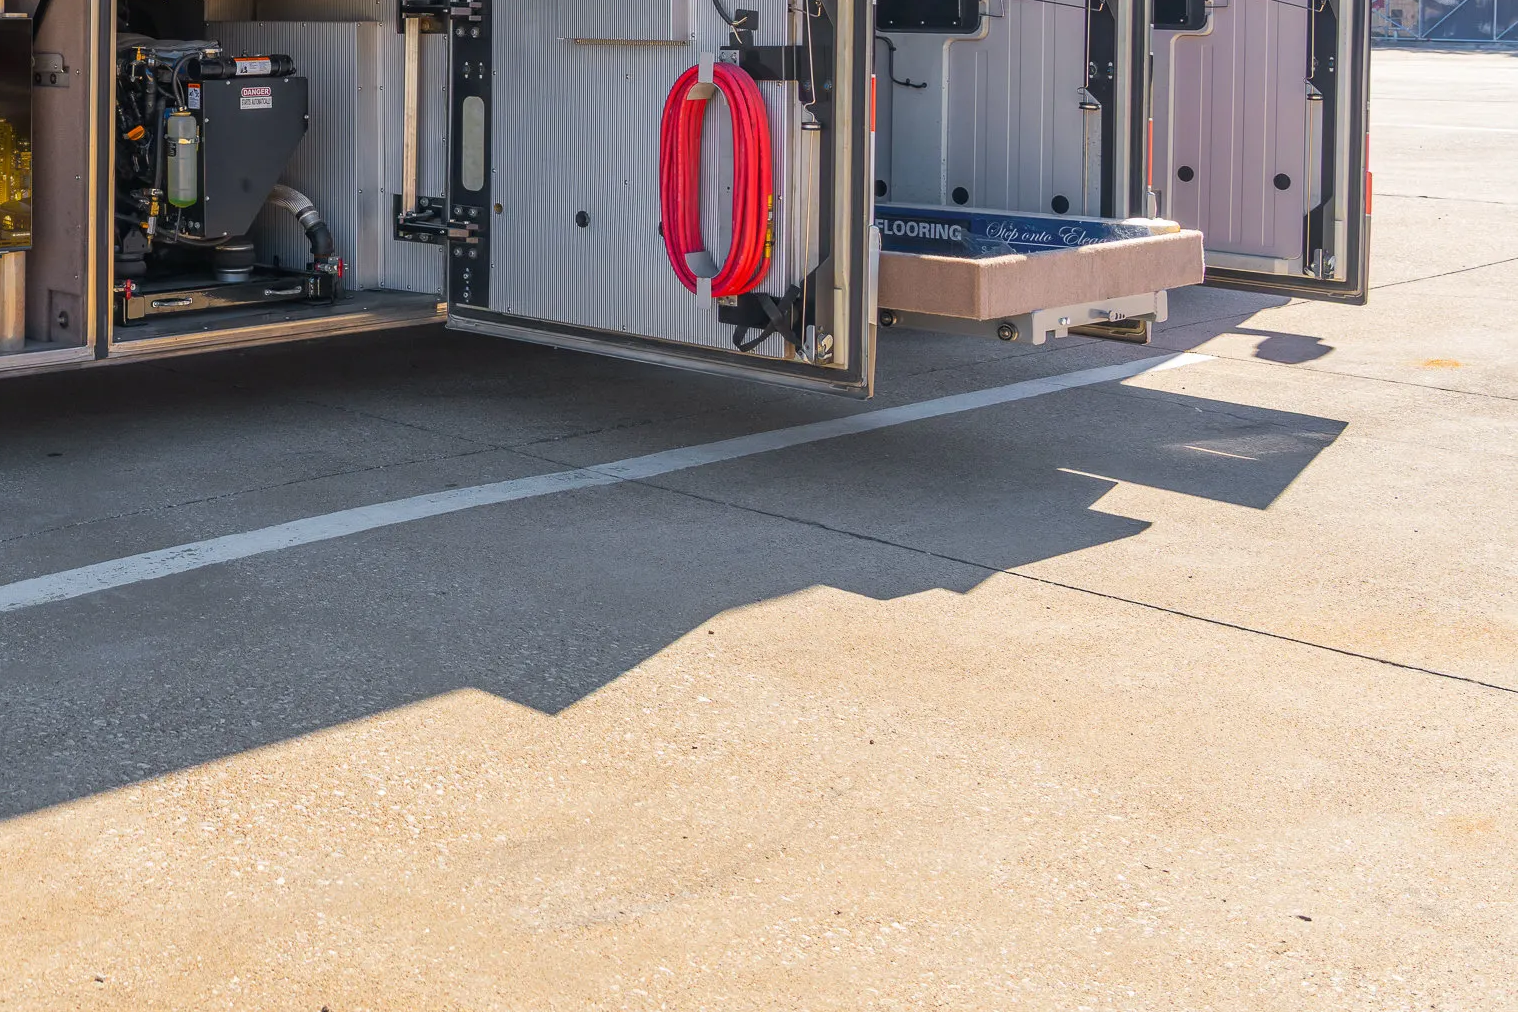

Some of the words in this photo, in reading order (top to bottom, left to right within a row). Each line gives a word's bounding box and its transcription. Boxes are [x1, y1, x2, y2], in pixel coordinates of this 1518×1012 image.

[875, 219, 962, 241] FLOORING
[986, 221, 1019, 242] Step
[1022, 231, 1052, 243] onto
